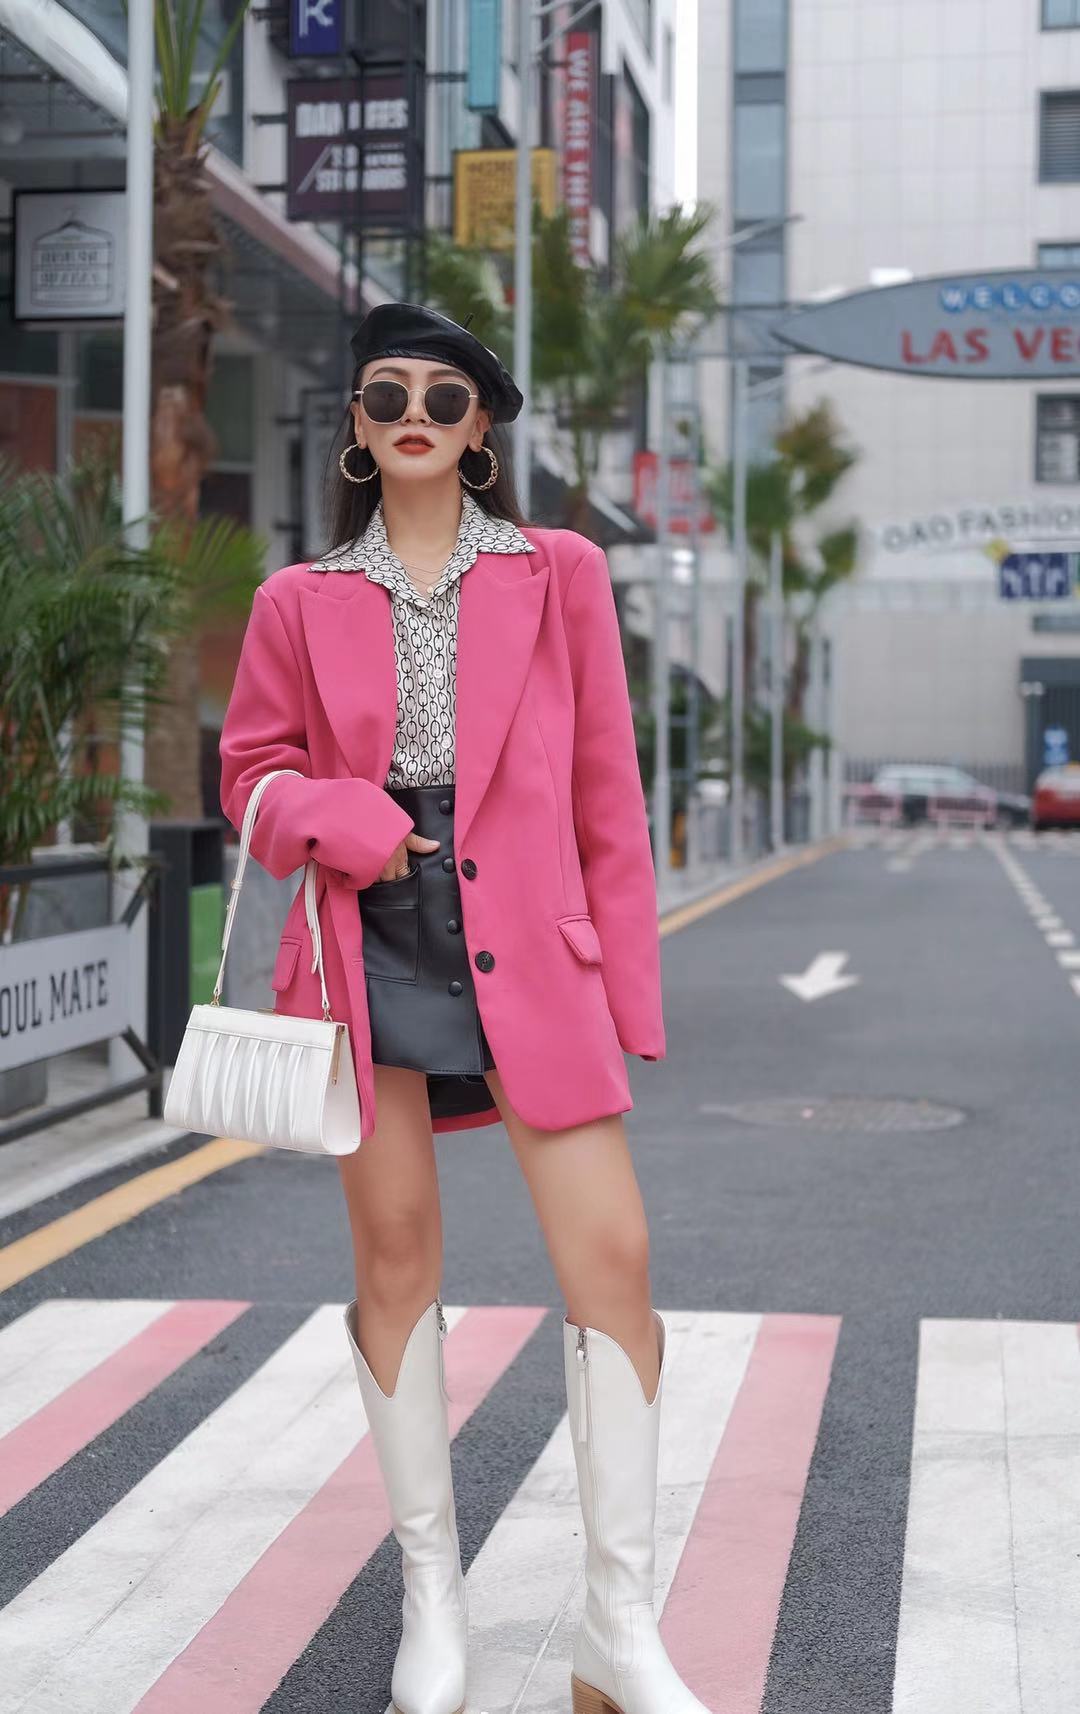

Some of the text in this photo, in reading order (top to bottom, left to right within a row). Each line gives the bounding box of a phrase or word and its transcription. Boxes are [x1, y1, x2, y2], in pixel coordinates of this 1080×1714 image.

[568, 49, 590, 91] WE
[567, 98, 590, 149] ARE
[902, 325, 1080, 364] LAS VE
[957, 505, 1080, 536] FASHIO
[50, 960, 108, 1021] MATE
